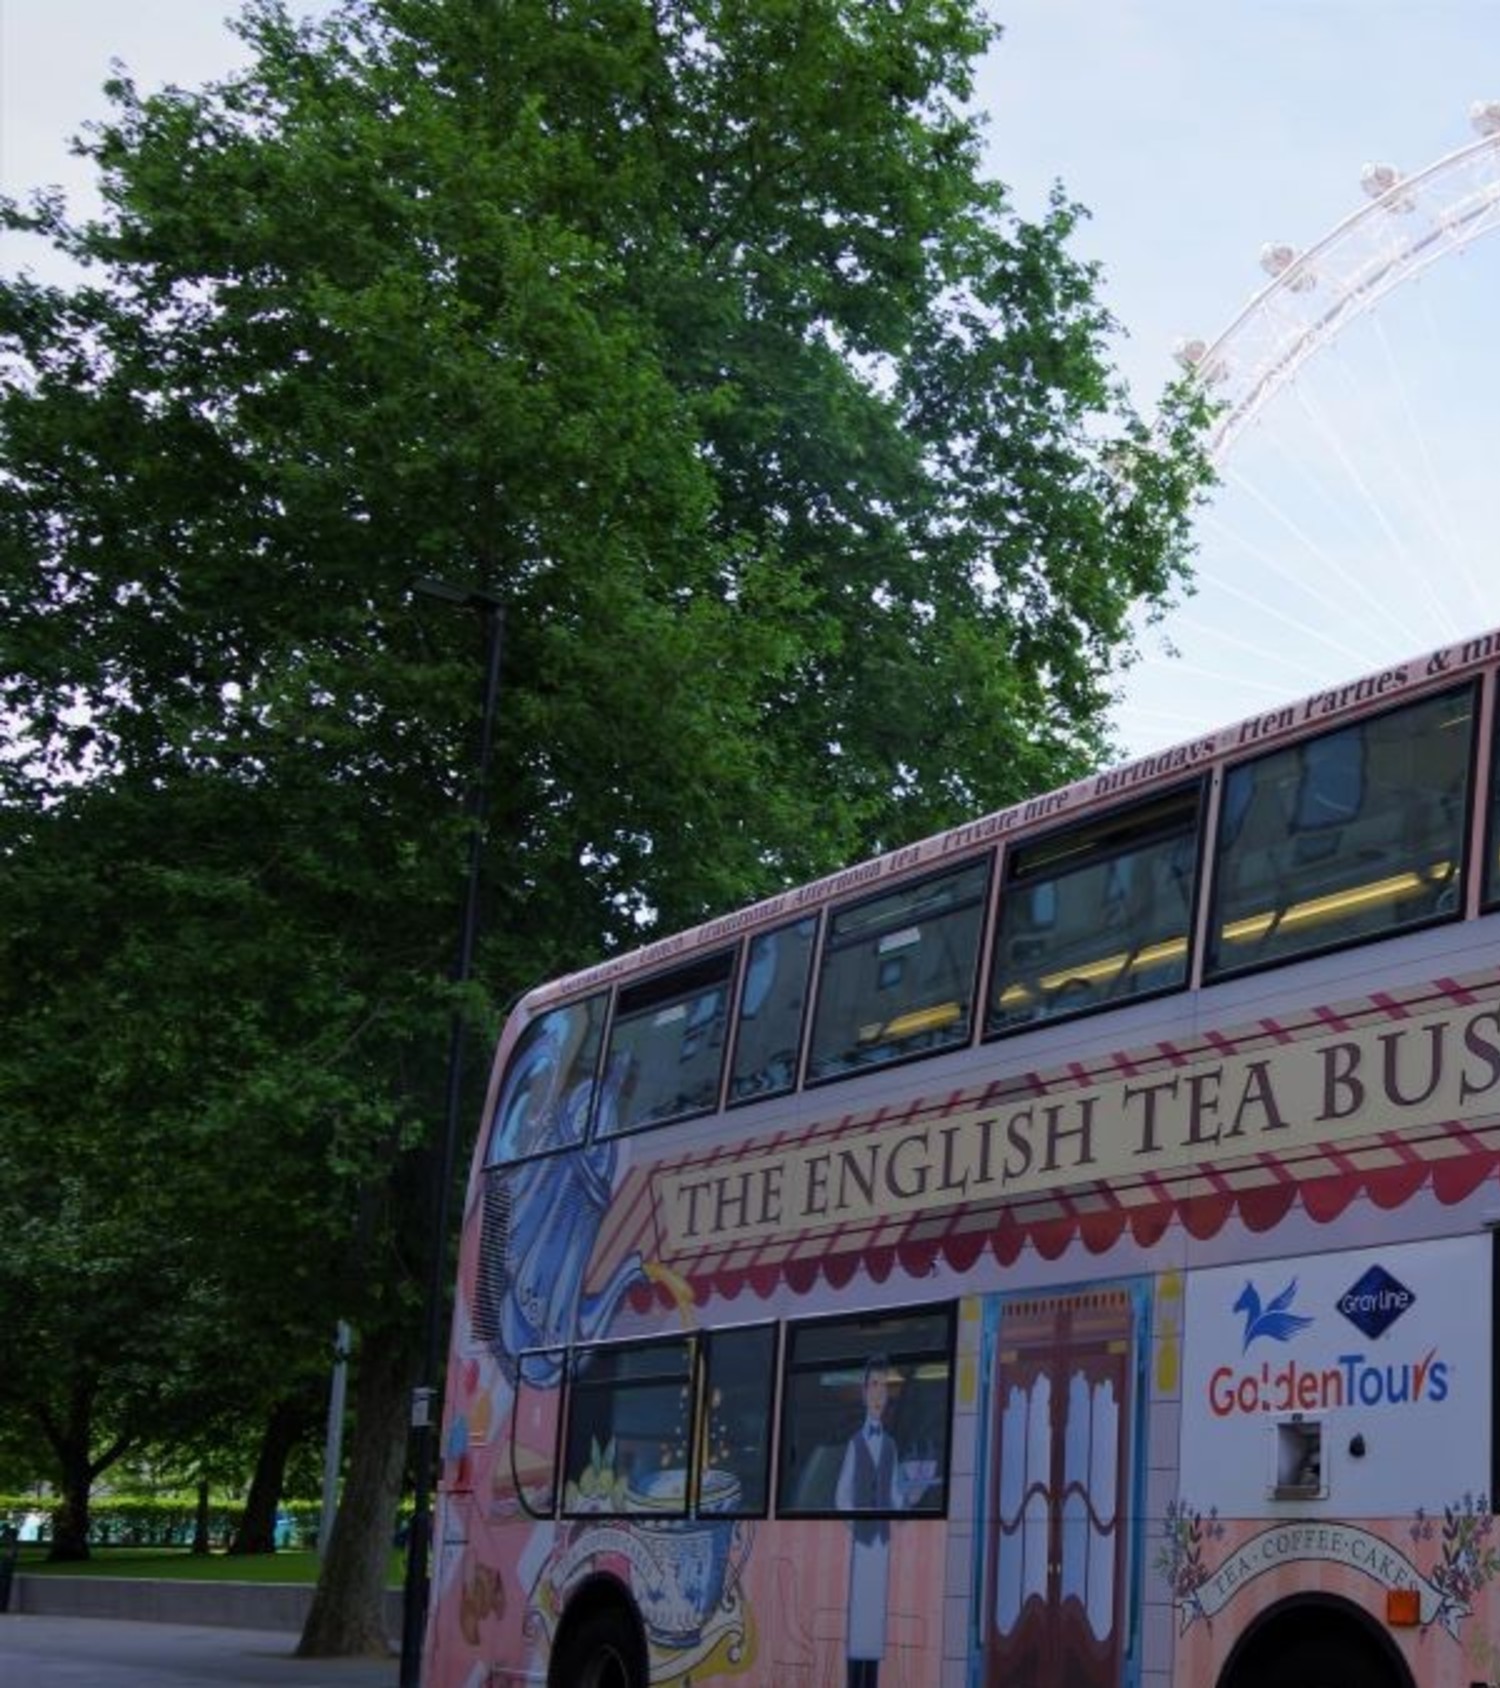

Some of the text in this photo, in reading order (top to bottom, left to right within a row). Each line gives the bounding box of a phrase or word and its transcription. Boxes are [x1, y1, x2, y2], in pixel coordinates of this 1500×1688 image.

[1303, 661, 1409, 719] Parties
[1426, 649, 1451, 676] &
[678, 1163, 786, 1239] THE
[799, 1097, 1101, 1217] ENGLISH
[1122, 1059, 1290, 1155] TEA
[1261, 1529, 1345, 1560] COFFEE
